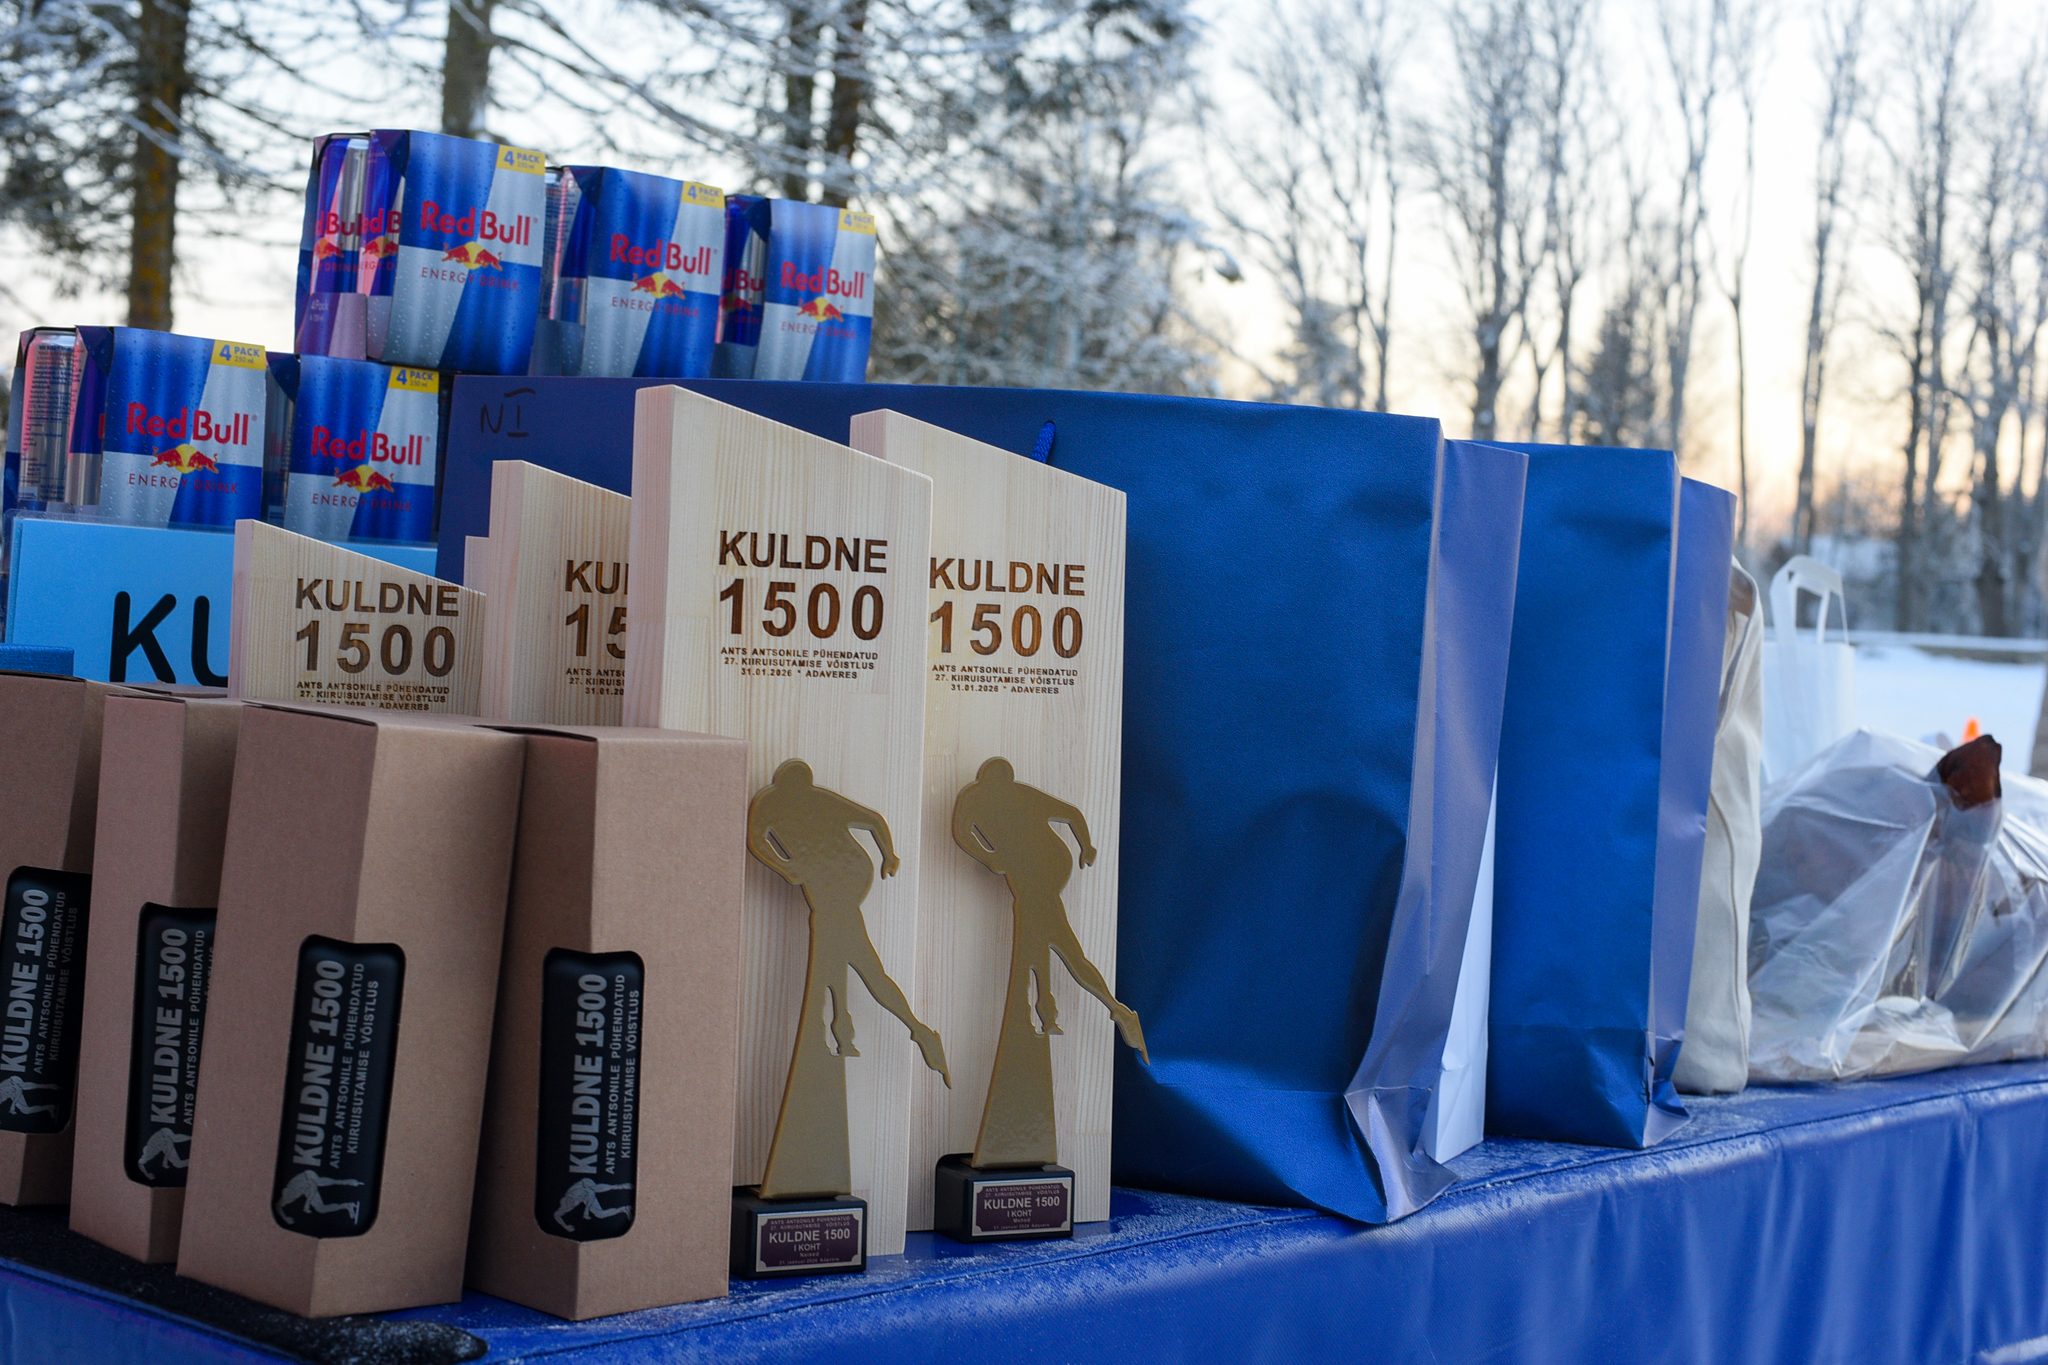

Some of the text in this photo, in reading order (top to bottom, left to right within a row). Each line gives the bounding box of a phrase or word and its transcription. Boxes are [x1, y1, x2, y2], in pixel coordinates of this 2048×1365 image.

[504, 151, 540, 165] 4 PACK
[688, 186, 697, 200] 4
[699, 187, 719, 197] PACK
[421, 200, 476, 237] Red
[480, 210, 530, 246] Bull
[844, 214, 852, 226] 4
[610, 233, 710, 276] Red Bull
[422, 268, 519, 290] ENERGY DRINK
[781, 261, 864, 298] Red Bull
[612, 297, 700, 318] ENERGY DRINK
[781, 322, 856, 339] ENERGY DRINK
[220, 345, 260, 361] 4 PACK
[396, 369, 434, 386] 4 PACK
[127, 402, 187, 439] Red
[193, 410, 248, 445] Bull
[311, 426, 366, 460] Red
[371, 432, 422, 466] Bull
[129, 474, 238, 494] ENERGY DRINK
[313, 494, 411, 512] ENERGY DRINK
[719, 530, 888, 573] KULDNE
[565, 560, 629, 595] KU
[930, 558, 1085, 596] KULDNE
[296, 578, 459, 616] KULDNE
[720, 579, 884, 640] 1500
[931, 601, 1083, 658] 1500
[297, 621, 456, 677] 1500
[721, 647, 878, 660] ANTS ANTSONILE PÜHENDATUD
[566, 668, 592, 676] ANTS
[725, 657, 874, 669] 27. KIIRUISUTAMISE VÕISTLUS
[741, 668, 857, 679] 31.01.2026 ADAVERES
[961, 666, 1013, 674] ANTSONILE
[1018, 666, 1078, 676] PÜHENDATUD
[327, 683, 381, 692] ANTSONILE
[387, 684, 450, 694] PÜHENDATUD
[586, 678, 625, 686] KIIRUIS
[935, 674, 1075, 686] 27. KIIRUISUTAMISE VÕISTLUS
[951, 684, 1059, 694] 31.01.2026 ADAVERES
[317, 692, 395, 701] KIIRUISUTAMISE
[400, 692, 446, 703] VÕISTLUS
[379, 702, 429, 711] ADAVERES
[0, 889, 49, 1073] KULDNE 1500
[34, 892, 66, 1074] ANTS ANTSONILE PÜHENDATUD
[150, 928, 187, 1124] KULDNE 1500
[183, 930, 205, 1126] ANTS ANTSONILE PÜHENDATUD
[293, 960, 346, 1167] KULDNE 1500
[330, 963, 364, 1169] ANTS ANTSONILE PÜHENDATUD
[347, 980, 379, 1154] KIIRUISUTAMISE VÕISTLUS
[569, 974, 607, 1174] KULDNE 1500
[621, 990, 639, 1158] KIIRUISUTAMISE VÕISTLUS
[606, 974, 625, 1175] ANTS ANTSONILE PÜHENDATUD
[984, 1196, 1060, 1210] KULDNE 1500
[1007, 1210, 1010, 1218] I
[769, 1228, 850, 1244] KULDNE 1500
[794, 1243, 821, 1252] I KOHT
